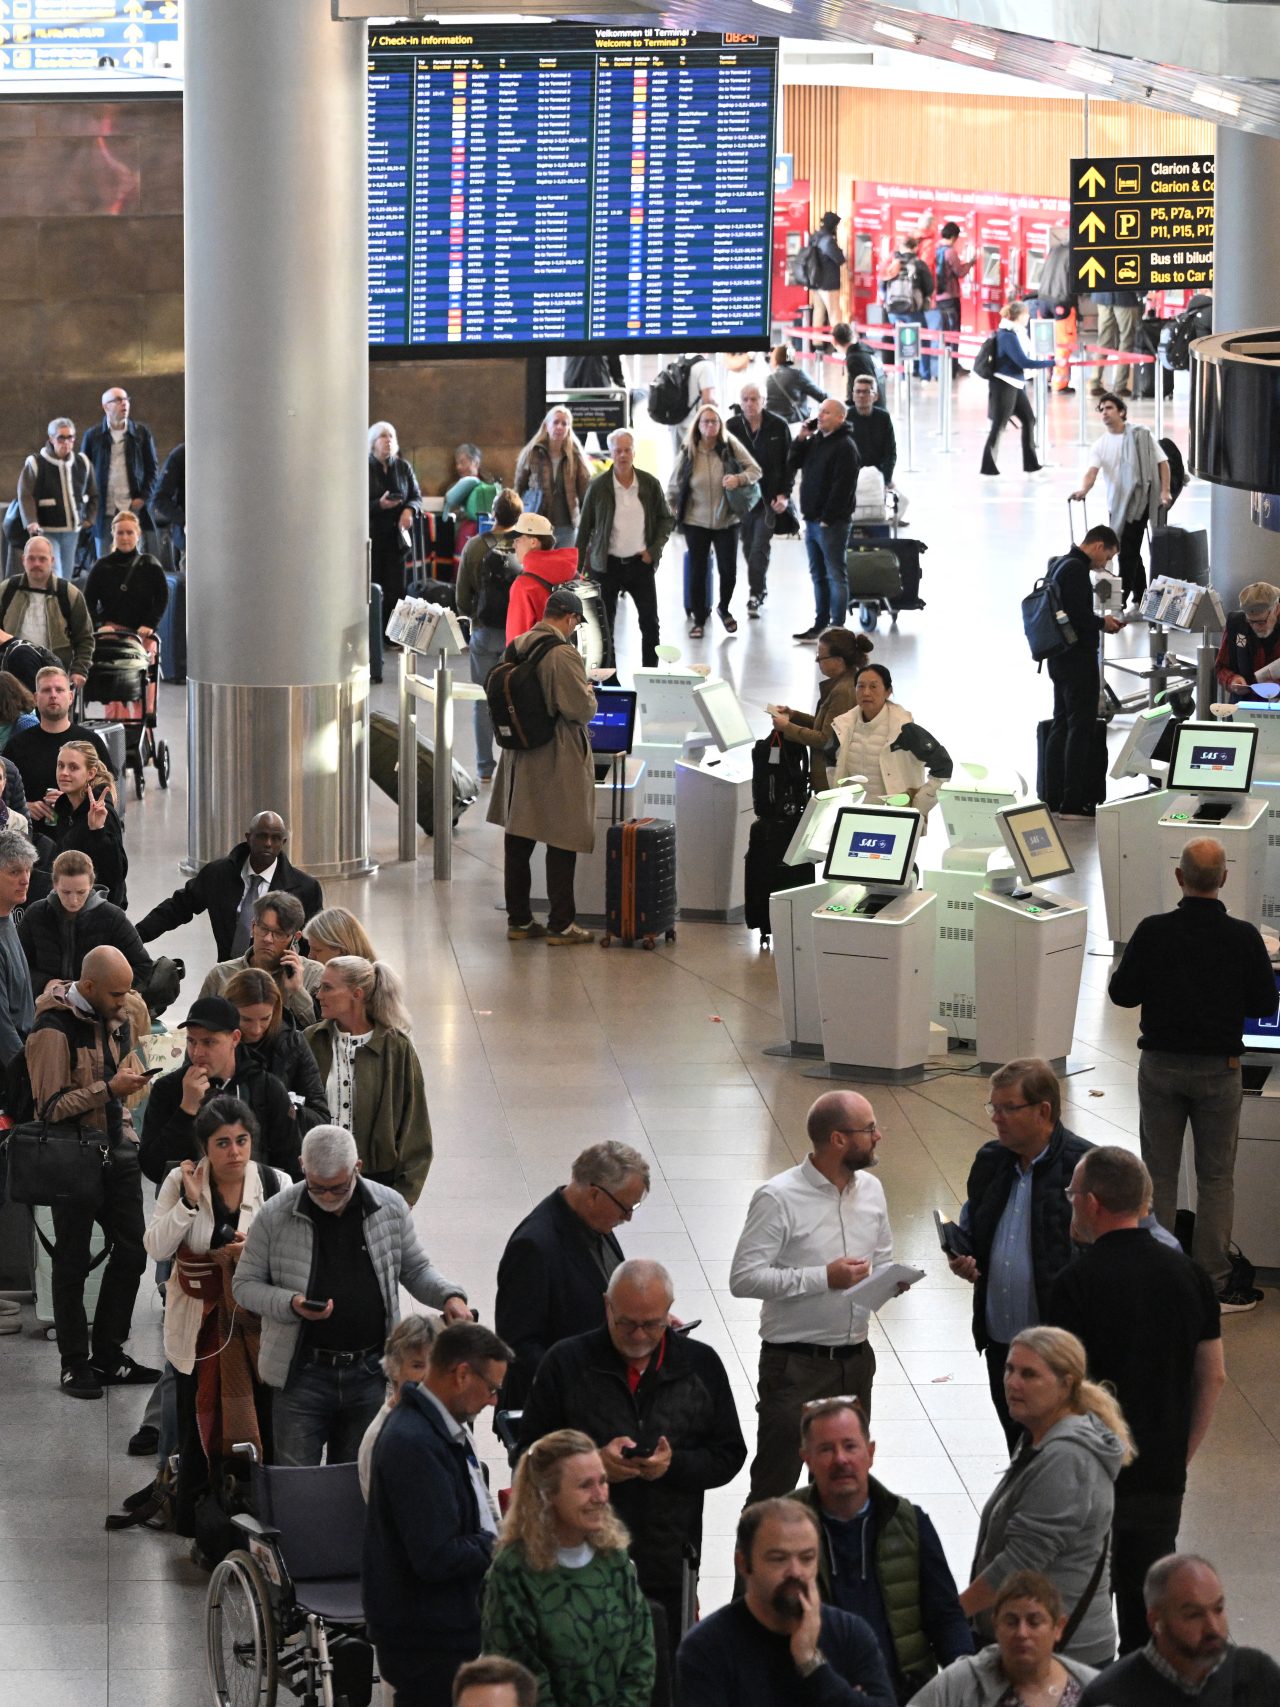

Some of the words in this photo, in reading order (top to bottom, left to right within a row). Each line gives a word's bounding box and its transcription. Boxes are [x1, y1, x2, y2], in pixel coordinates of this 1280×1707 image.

[596, 30, 642, 38] Velkommen
[379, 37, 419, 45] Check-in
[422, 36, 472, 44] information
[1151, 163, 1189, 175] Clarion
[1192, 162, 1200, 173] &
[1151, 181, 1189, 193] Clarion
[1192, 181, 1200, 191] &
[1151, 208, 1169, 221] P5,
[1171, 208, 1194, 220] P7a,
[1151, 226, 1171, 239] P11,
[1173, 225, 1194, 238] P15,
[1151, 253, 1170, 265] Bus
[1173, 253, 1183, 264] til
[1151, 271, 1170, 283] Bus
[1173, 270, 1184, 282] to
[1187, 270, 1205, 281] Car
[859, 838, 878, 847] SAS
[115, 1366, 131, 1377] N
